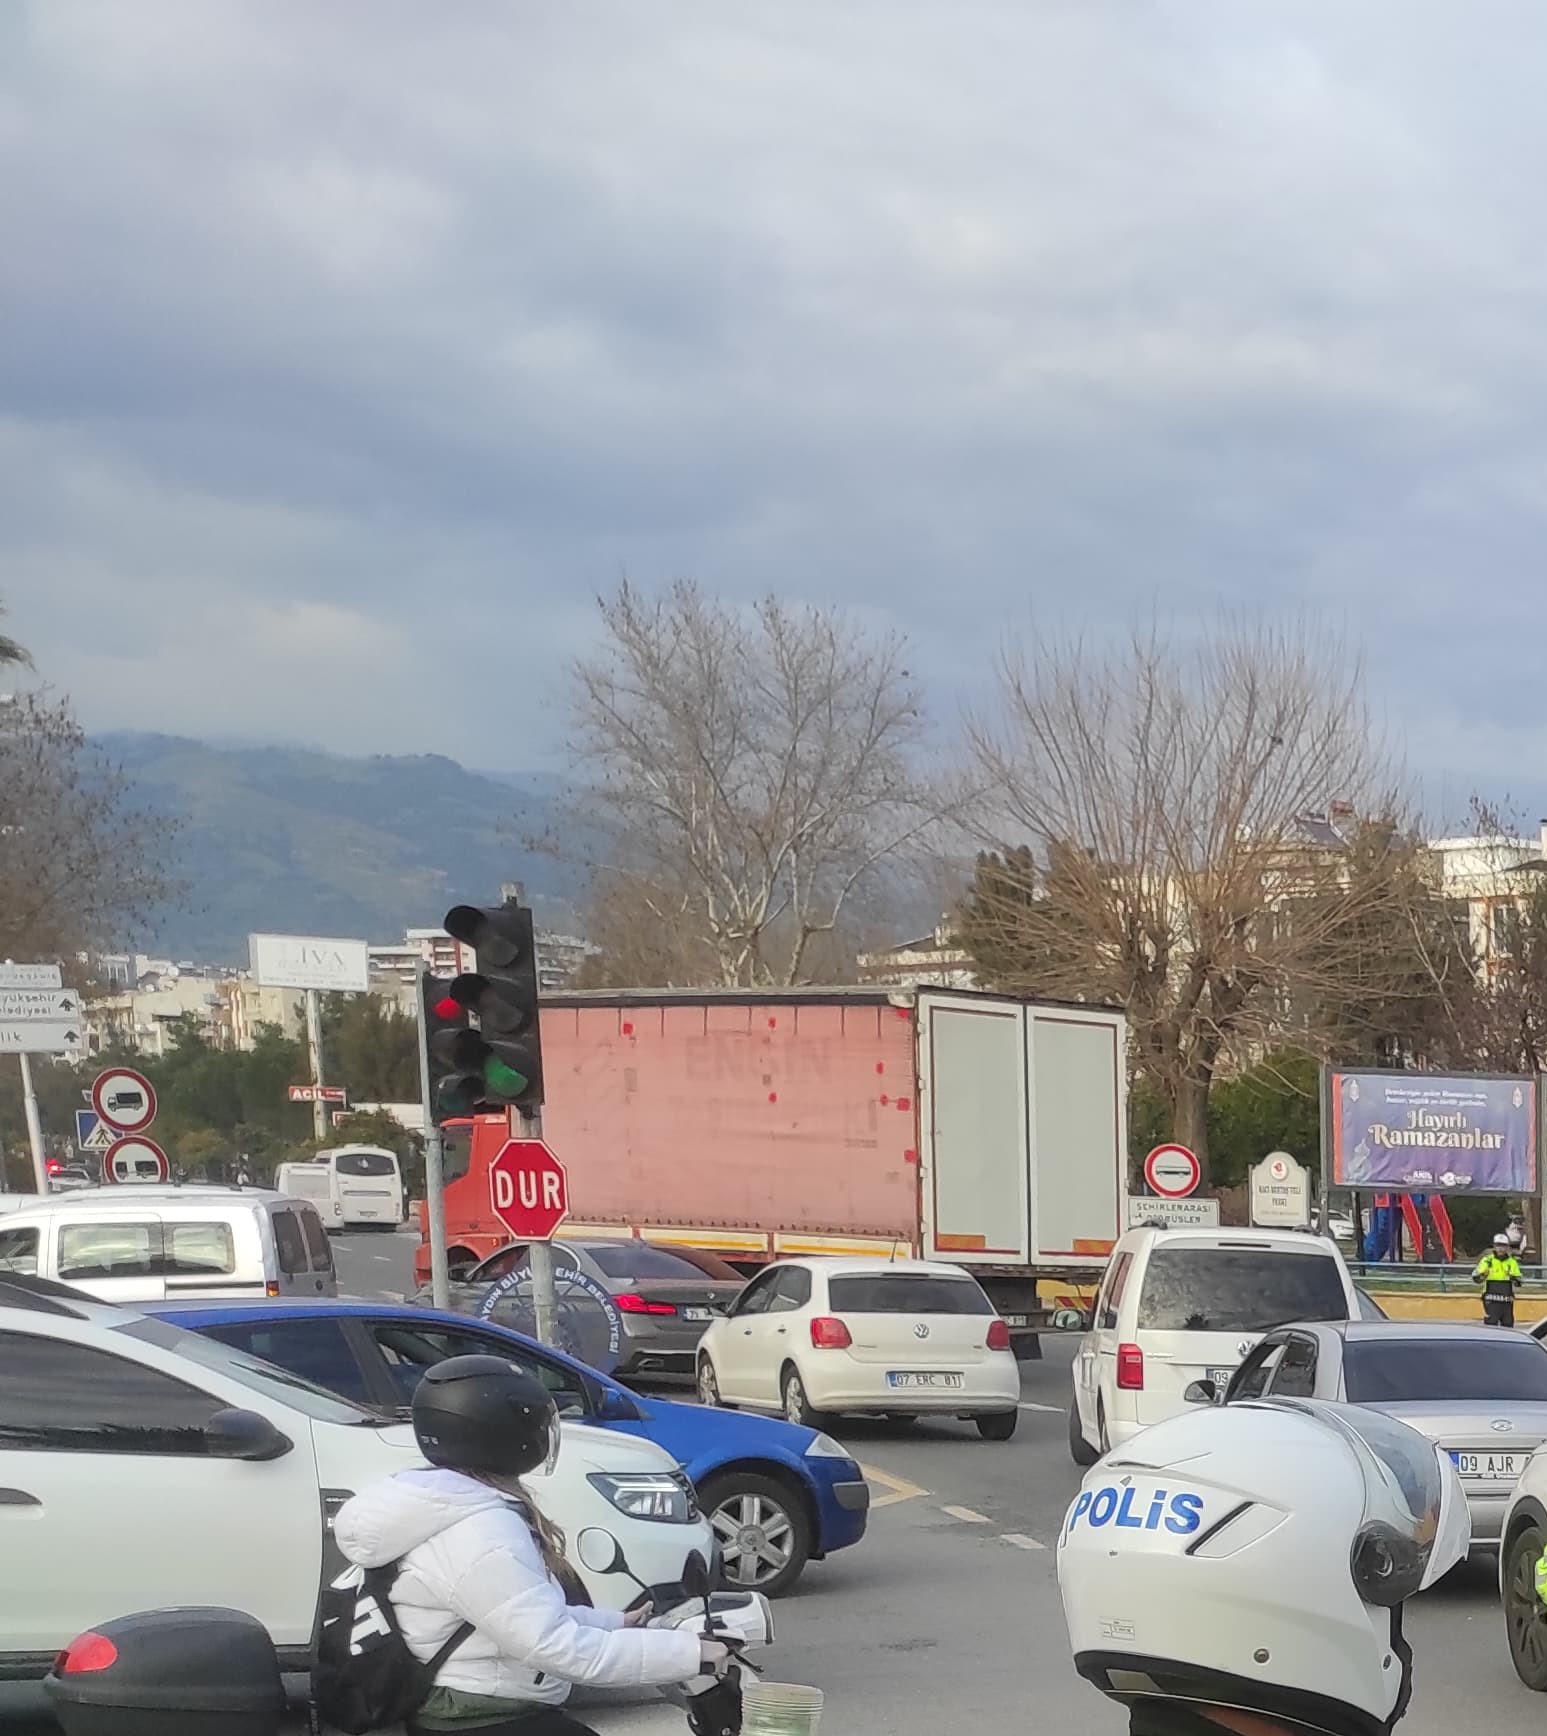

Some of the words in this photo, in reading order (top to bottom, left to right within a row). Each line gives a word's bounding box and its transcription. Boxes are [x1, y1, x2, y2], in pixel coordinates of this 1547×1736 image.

[1406, 1108, 1467, 1130] Hayırlı
[1368, 1124, 1505, 1150] Ramazanlar
[495, 1169, 562, 1210] DUR
[1460, 1455, 1478, 1472] 09
[1487, 1455, 1514, 1473] AJR
